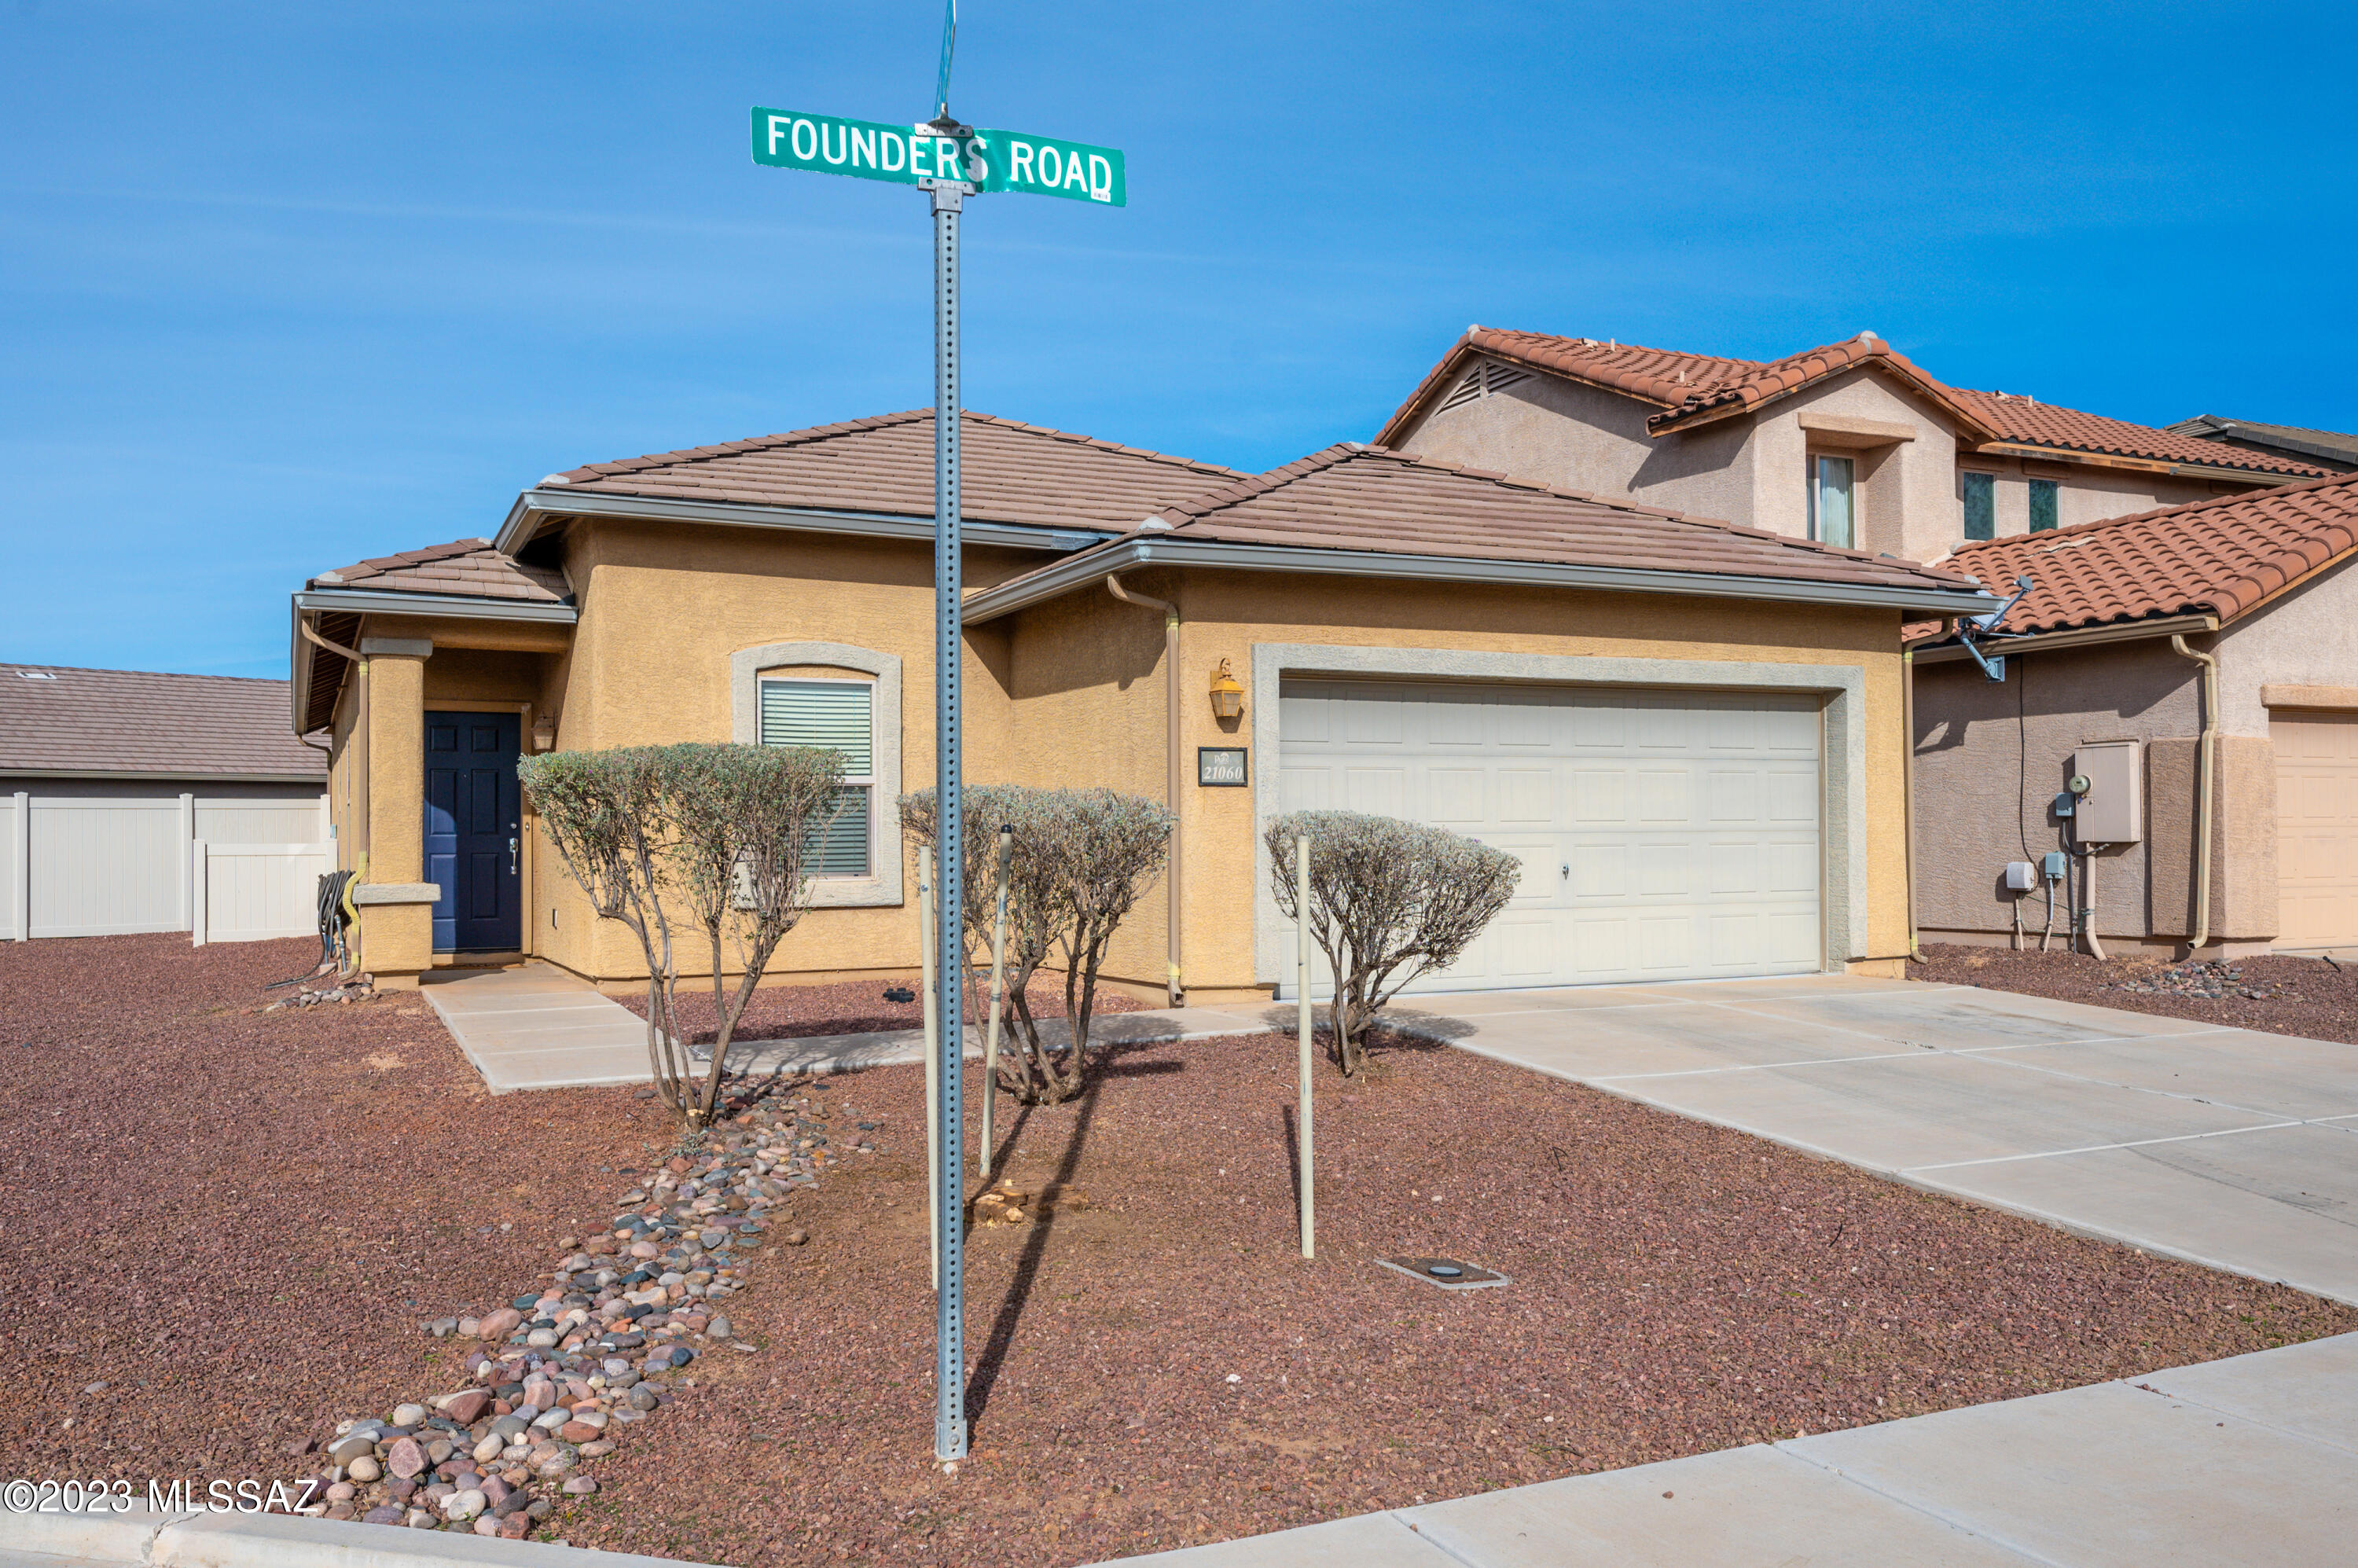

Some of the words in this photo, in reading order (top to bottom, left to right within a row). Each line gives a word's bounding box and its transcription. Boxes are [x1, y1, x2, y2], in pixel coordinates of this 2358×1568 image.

[767, 115, 989, 182] FOUNDERS
[1010, 141, 1112, 196] ROAD
[1203, 766, 1243, 780] 21060
